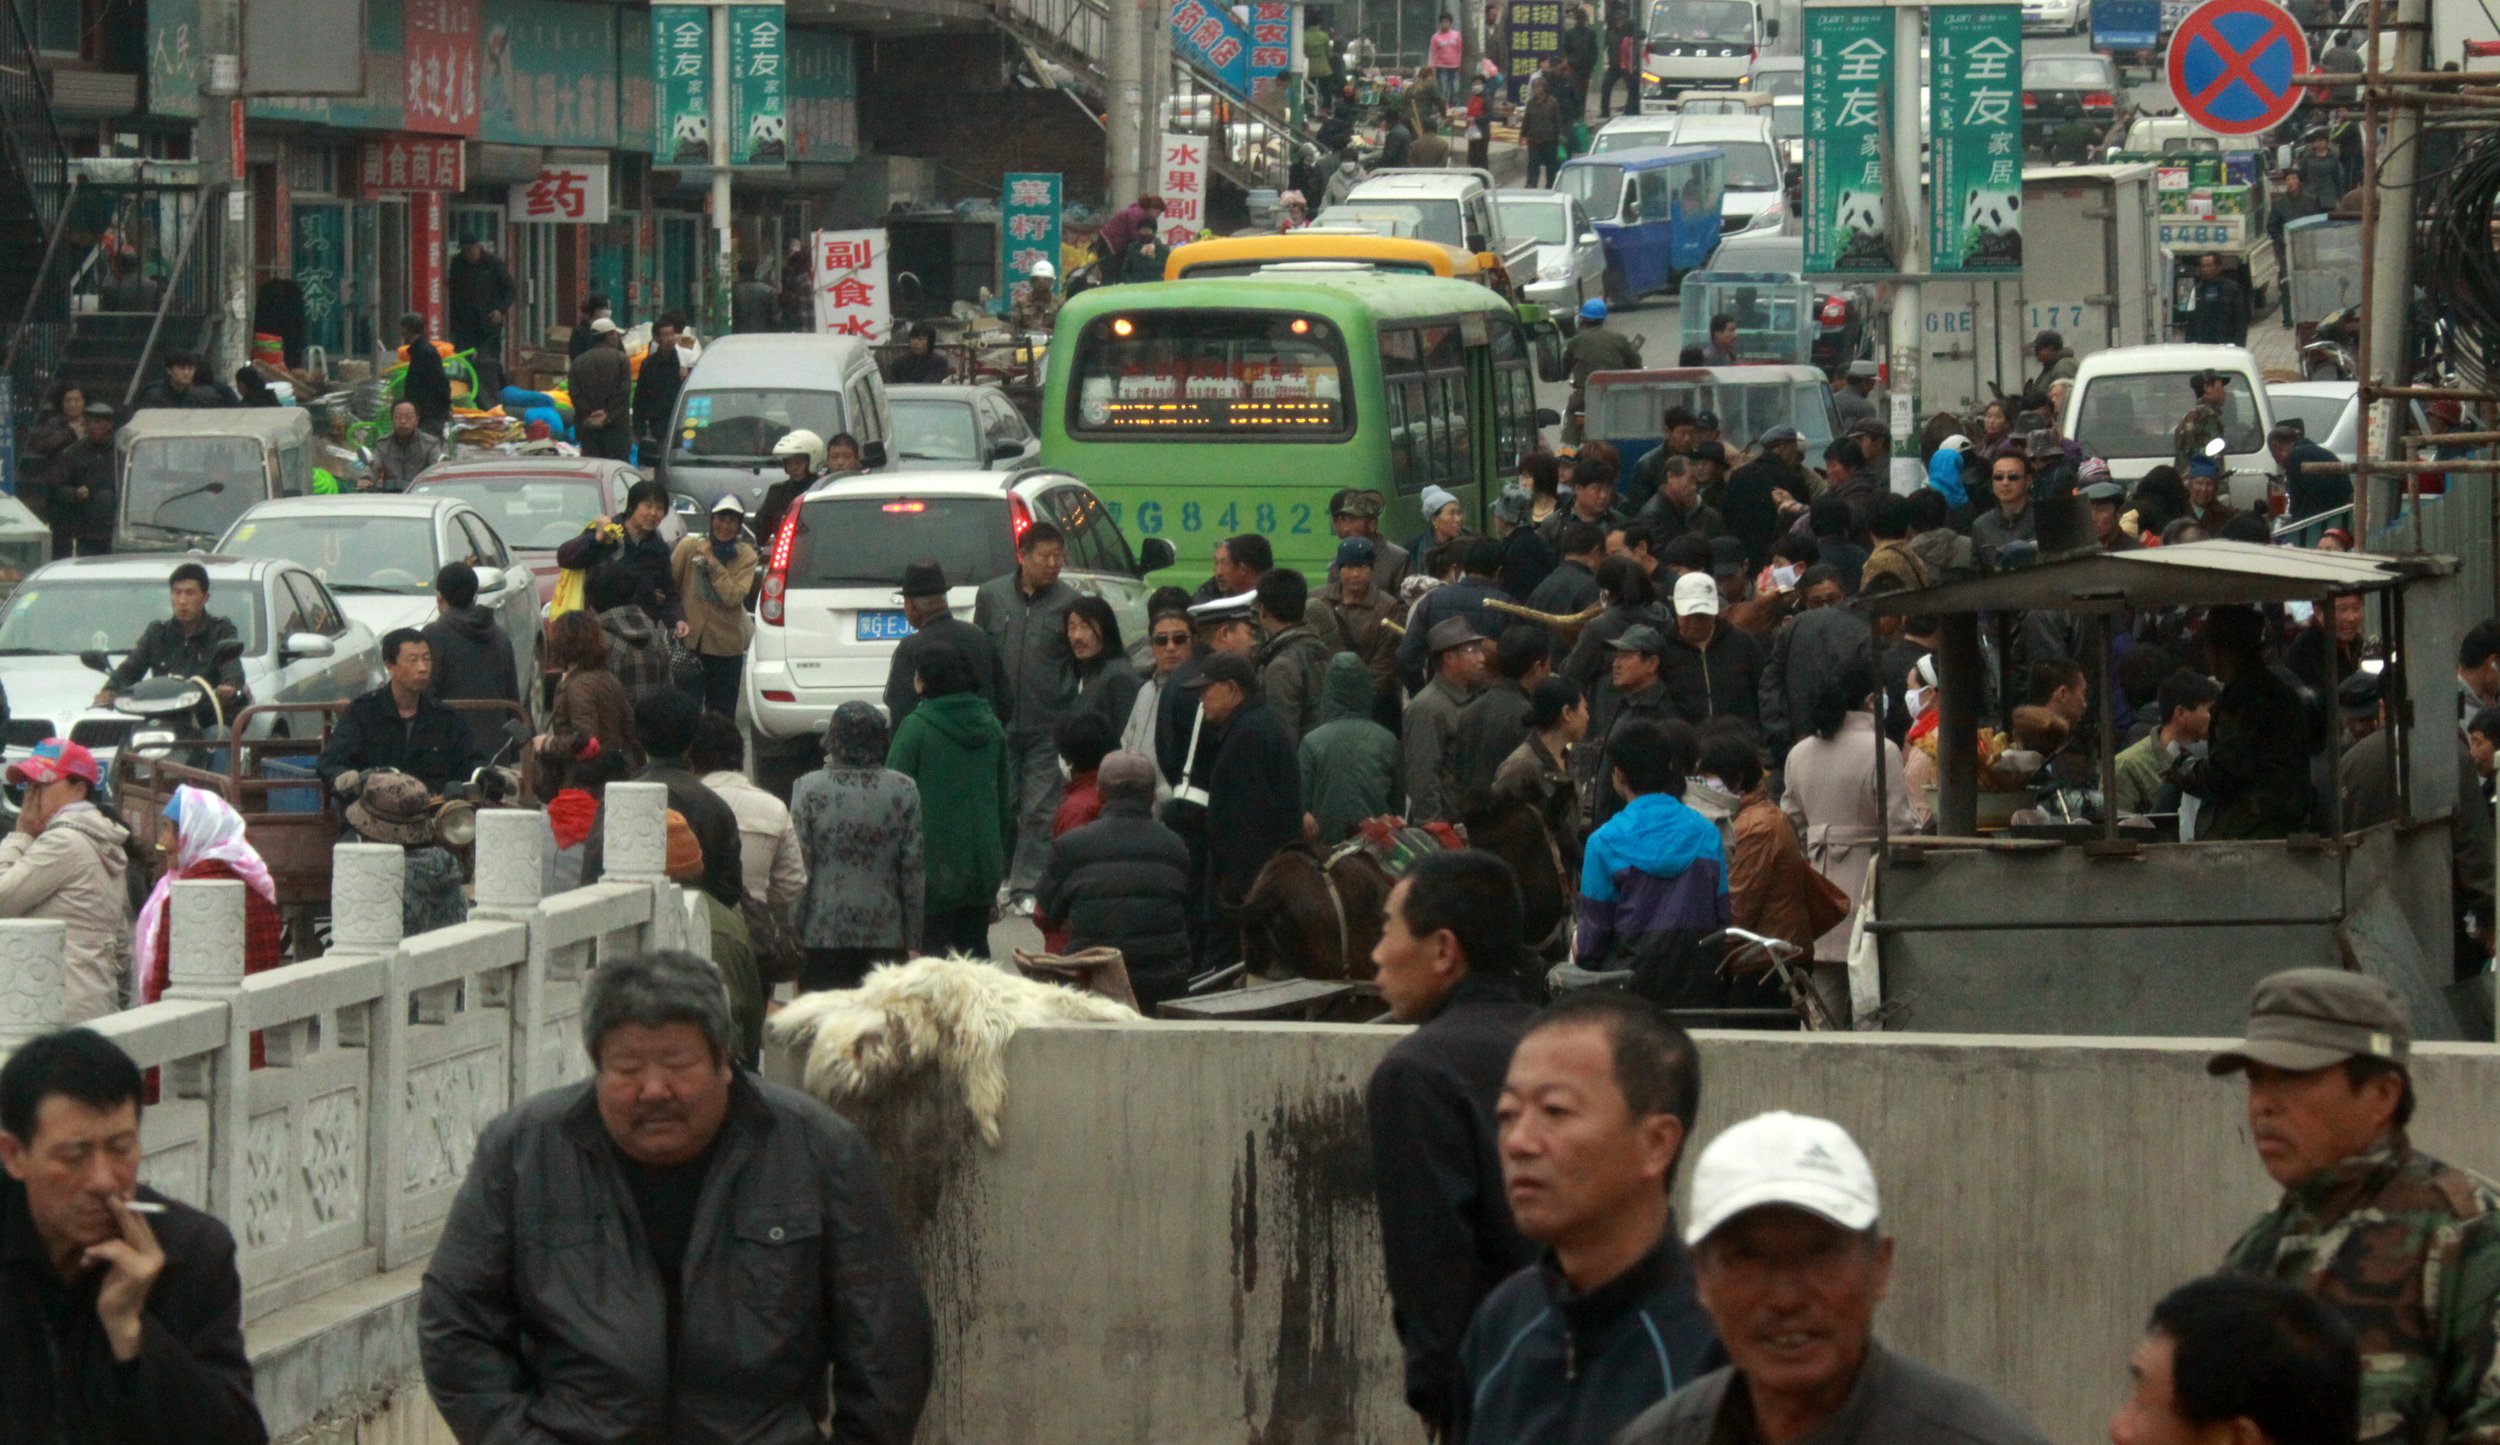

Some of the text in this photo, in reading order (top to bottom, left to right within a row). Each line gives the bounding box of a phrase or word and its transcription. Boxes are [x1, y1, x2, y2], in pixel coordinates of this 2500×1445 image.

[1170, 0, 1242, 68] 药商店
[1835, 37, 1887, 185] 全友家居
[1963, 37, 2015, 184] 全友家居
[364, 142, 457, 185] 副食商店
[526, 169, 588, 217] 药
[1164, 144, 1200, 247] 水果副食
[825, 239, 877, 341] 副食水
[2032, 306, 2082, 328] 177
[1107, 502, 1337, 534] G8482
